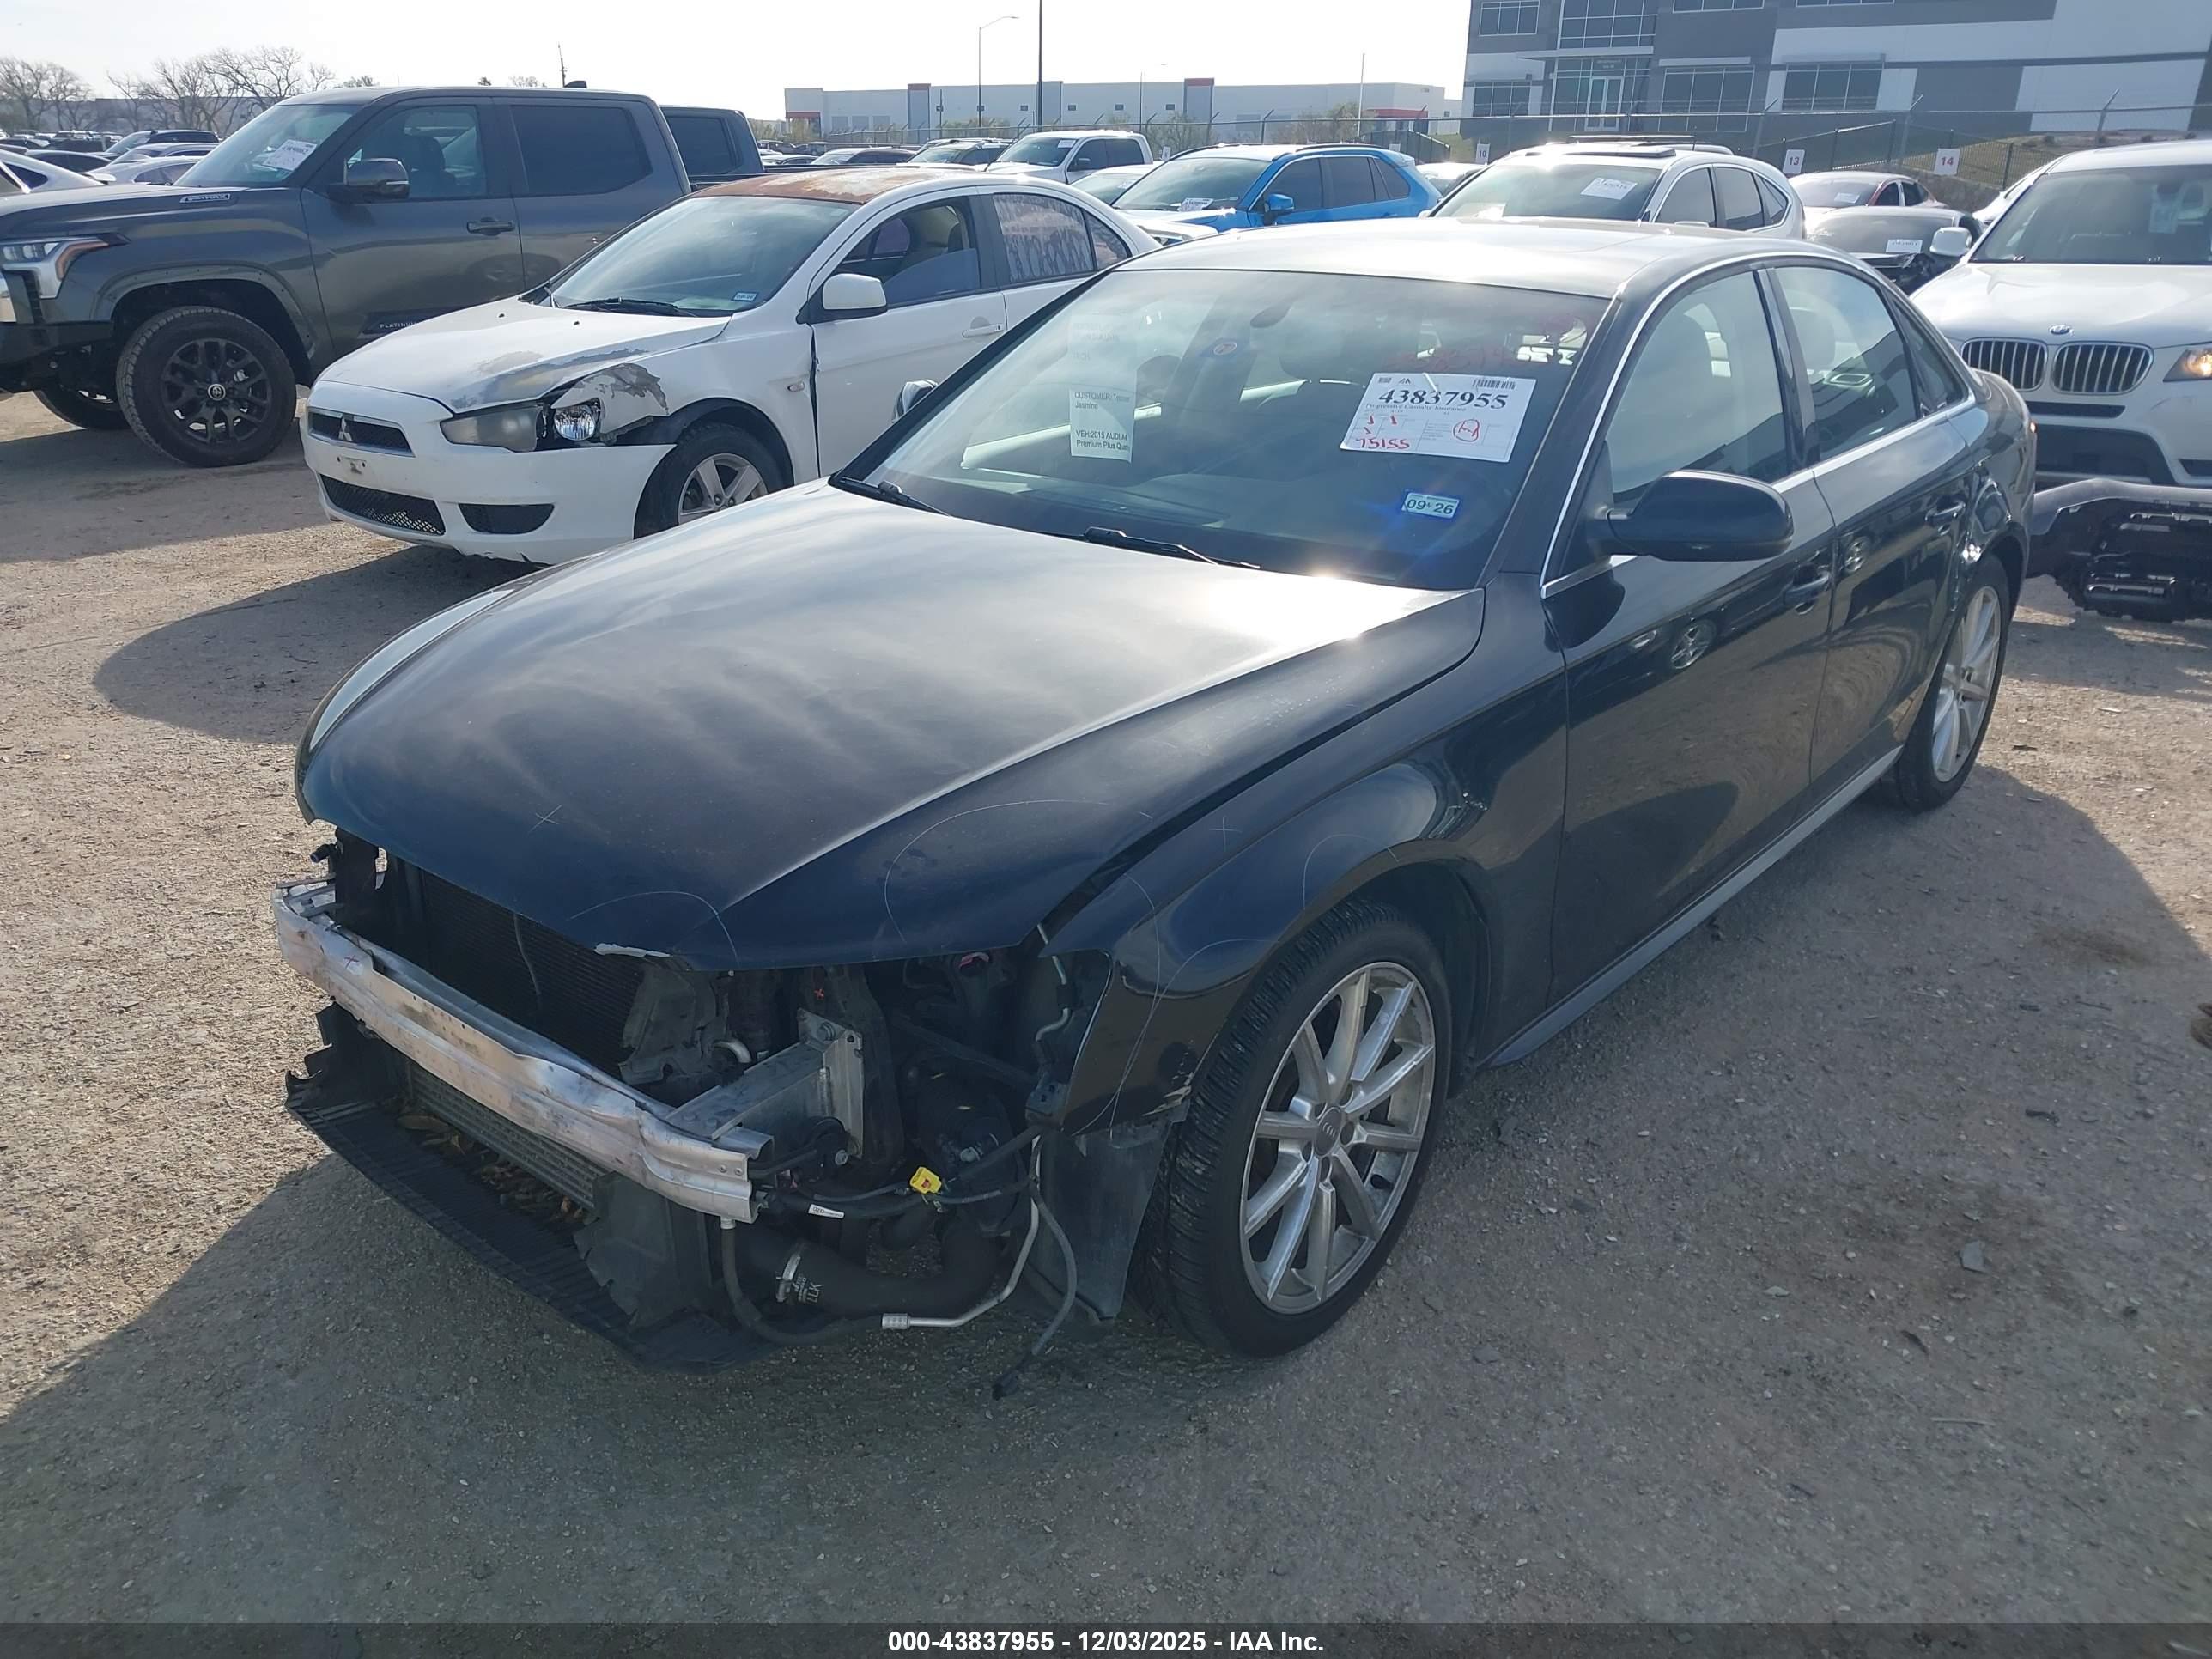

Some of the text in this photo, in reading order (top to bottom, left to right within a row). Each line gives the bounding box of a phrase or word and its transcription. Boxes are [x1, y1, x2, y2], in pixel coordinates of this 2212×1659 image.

[1789, 156, 1800, 166] 13
[1941, 156, 1954, 166] 14
[1378, 388, 1509, 409] 43837955
[1103, 441, 1115, 449] Plus
[1433, 502, 1454, 514] 26
